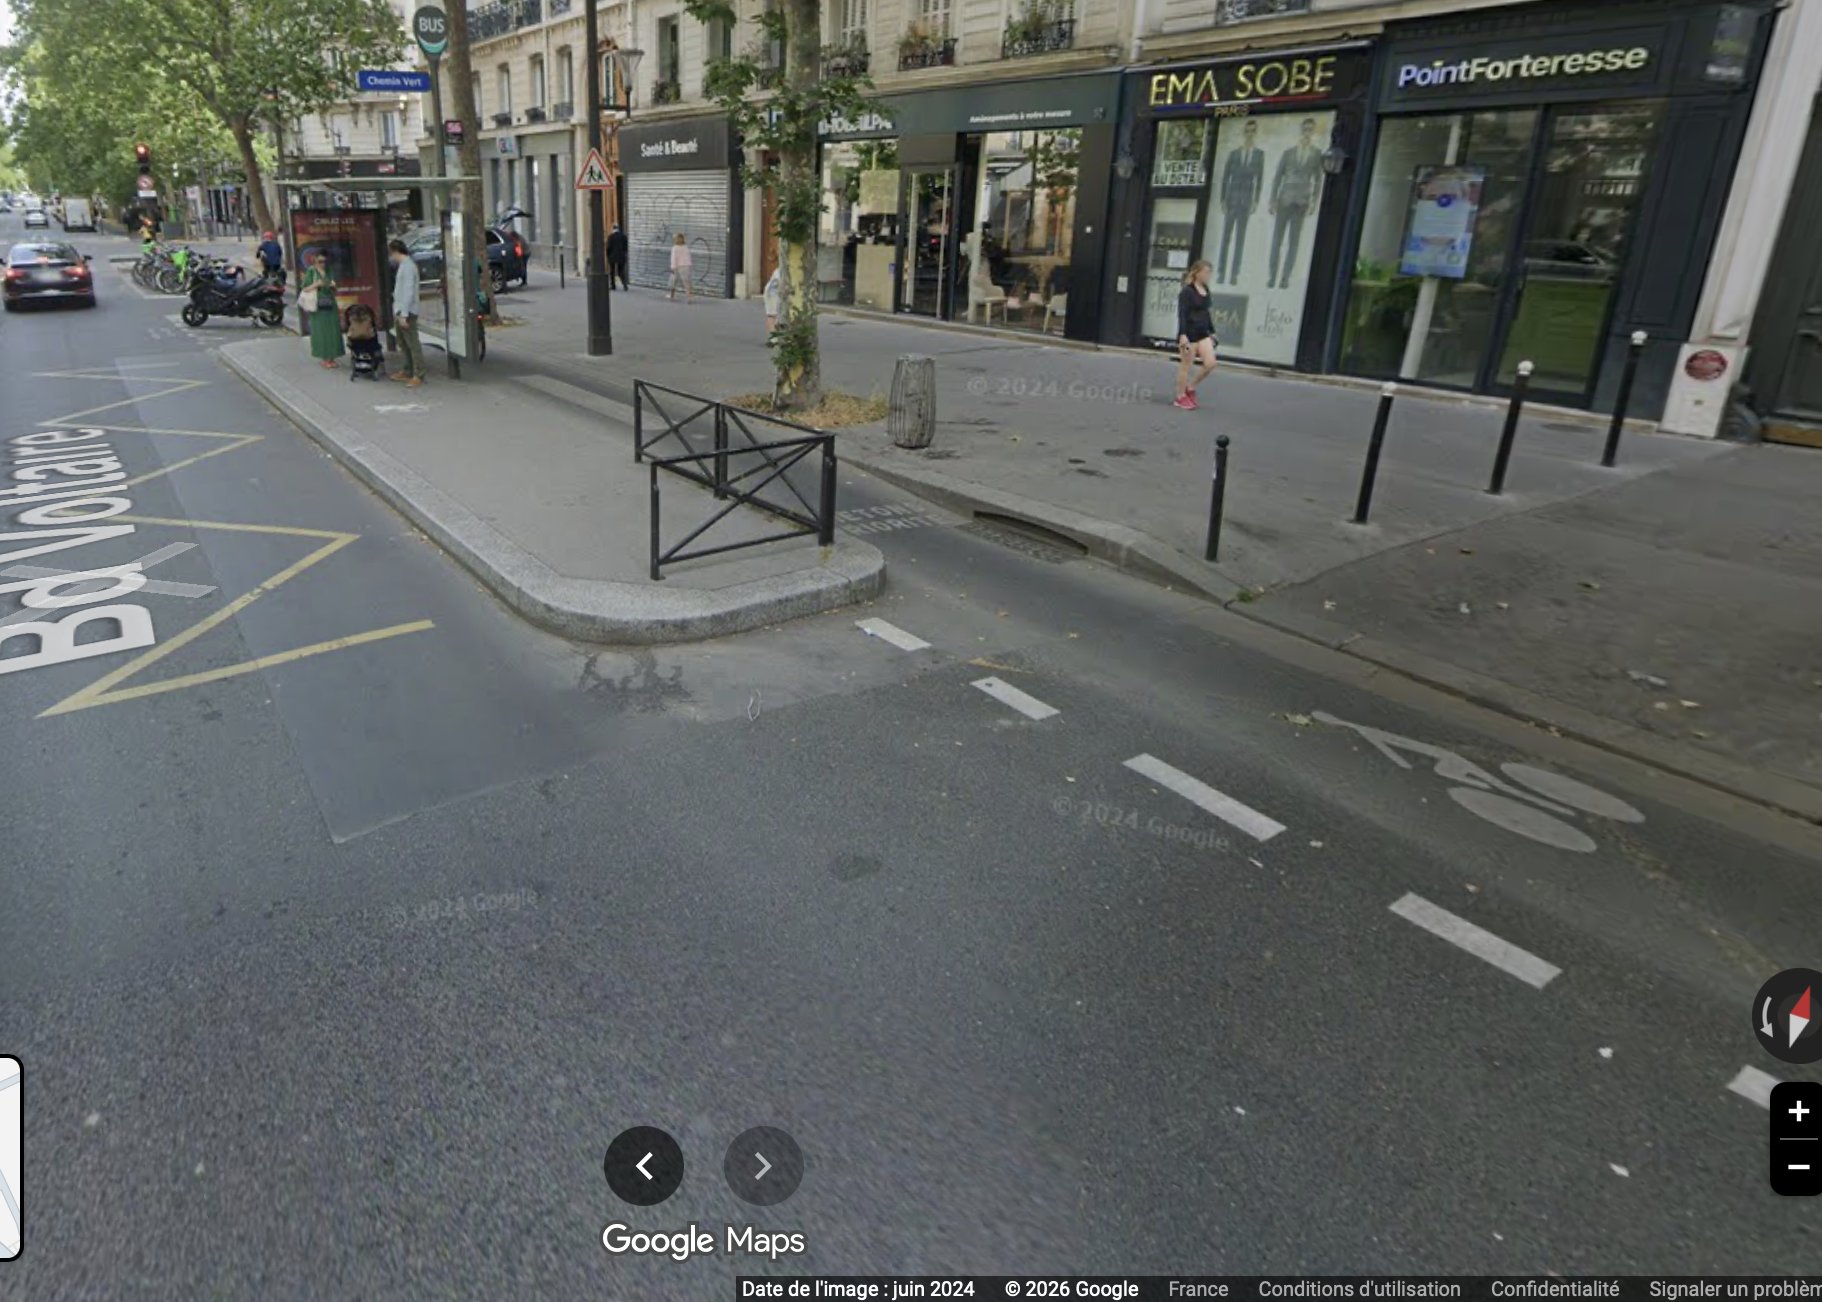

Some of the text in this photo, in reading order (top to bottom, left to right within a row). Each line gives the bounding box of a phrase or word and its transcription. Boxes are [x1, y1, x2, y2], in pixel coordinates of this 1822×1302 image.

[419, 17, 445, 33] BUS
[1398, 46, 1648, 88] PointForteresse
[366, 75, 422, 87] Chemin Vert
[1150, 56, 1337, 105] EMA SOBE
[1215, 105, 1249, 117] PARIS
[640, 141, 664, 158] Santé
[671, 136, 699, 155] Beauté
[1164, 161, 1199, 173] VENTE
